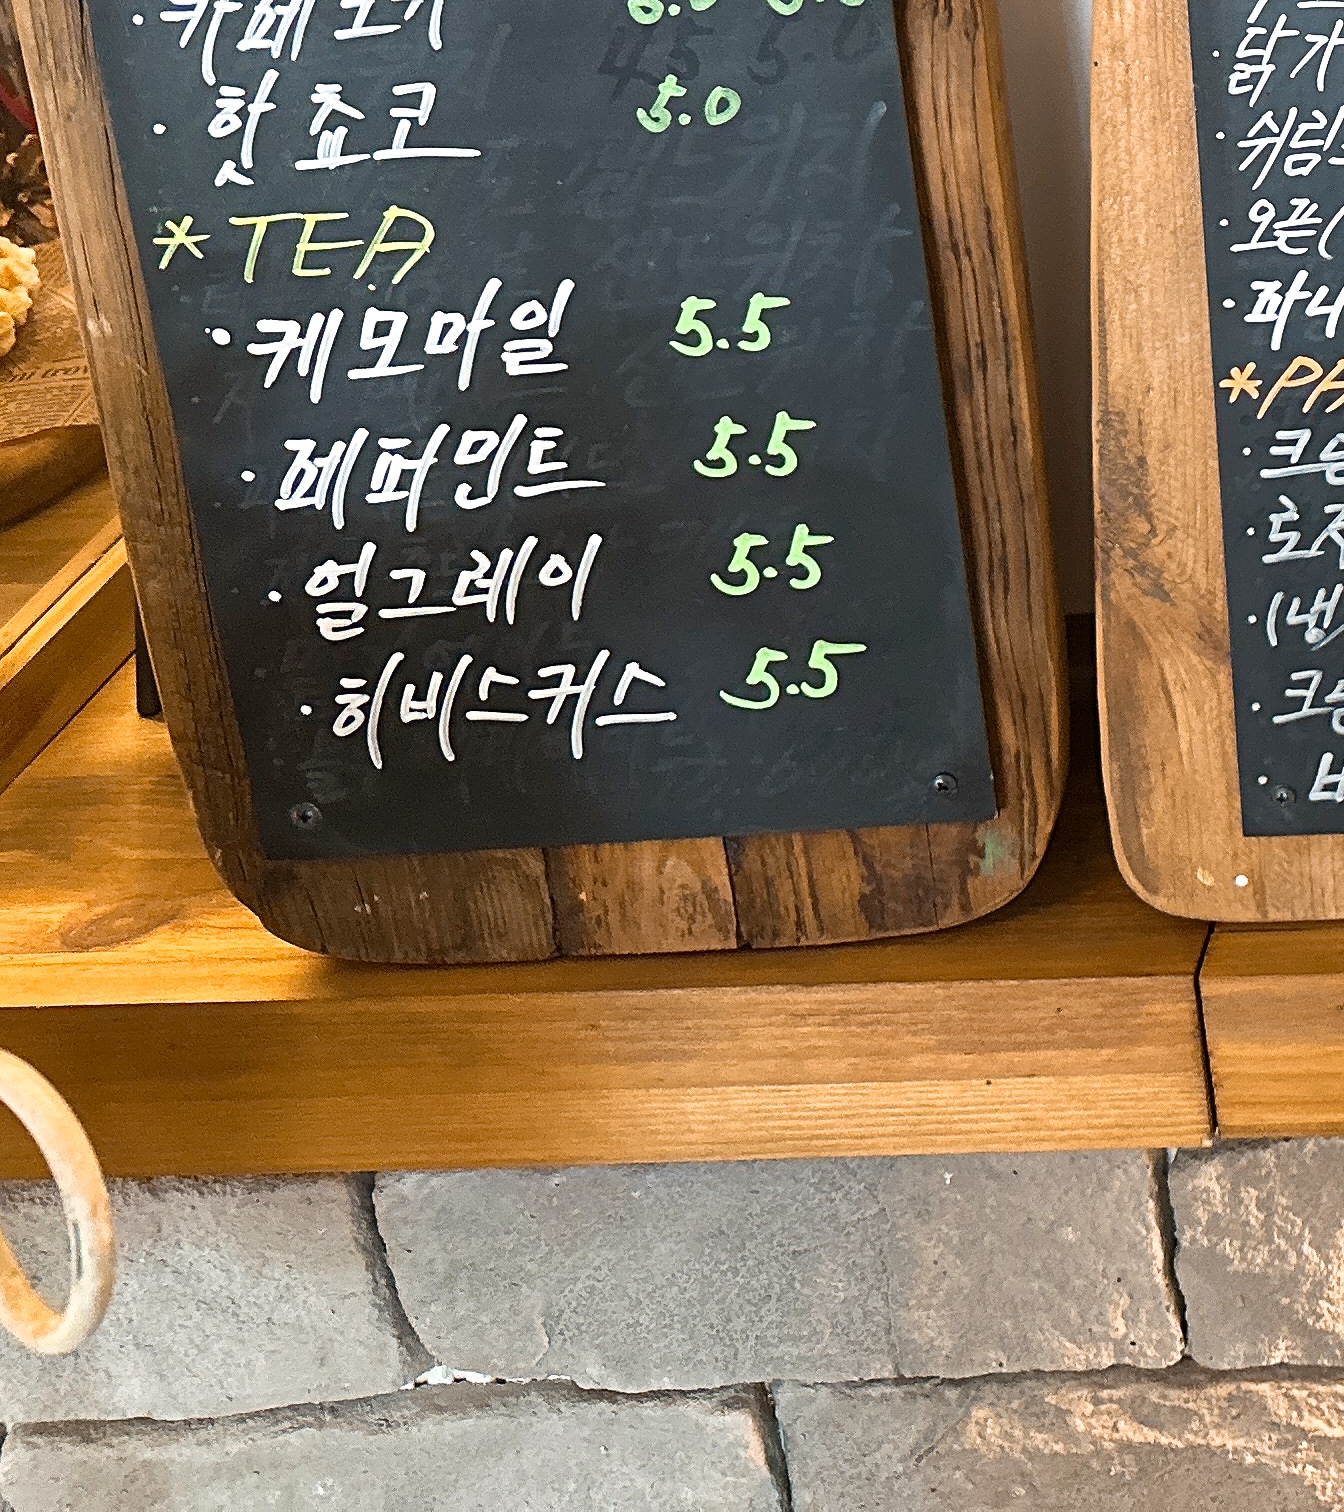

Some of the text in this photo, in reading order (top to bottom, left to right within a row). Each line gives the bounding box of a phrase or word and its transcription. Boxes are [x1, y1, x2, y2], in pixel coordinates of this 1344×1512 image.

[637, 74, 741, 132] 5.0
[229, 205, 434, 284] TEA
[247, 278, 790, 403] 케모마일 5.5
[275, 411, 816, 532] 페퍼민트 5.5
[305, 524, 834, 640] 얼그레이 5.5
[333, 640, 867, 769] 히비스커스 5.5
